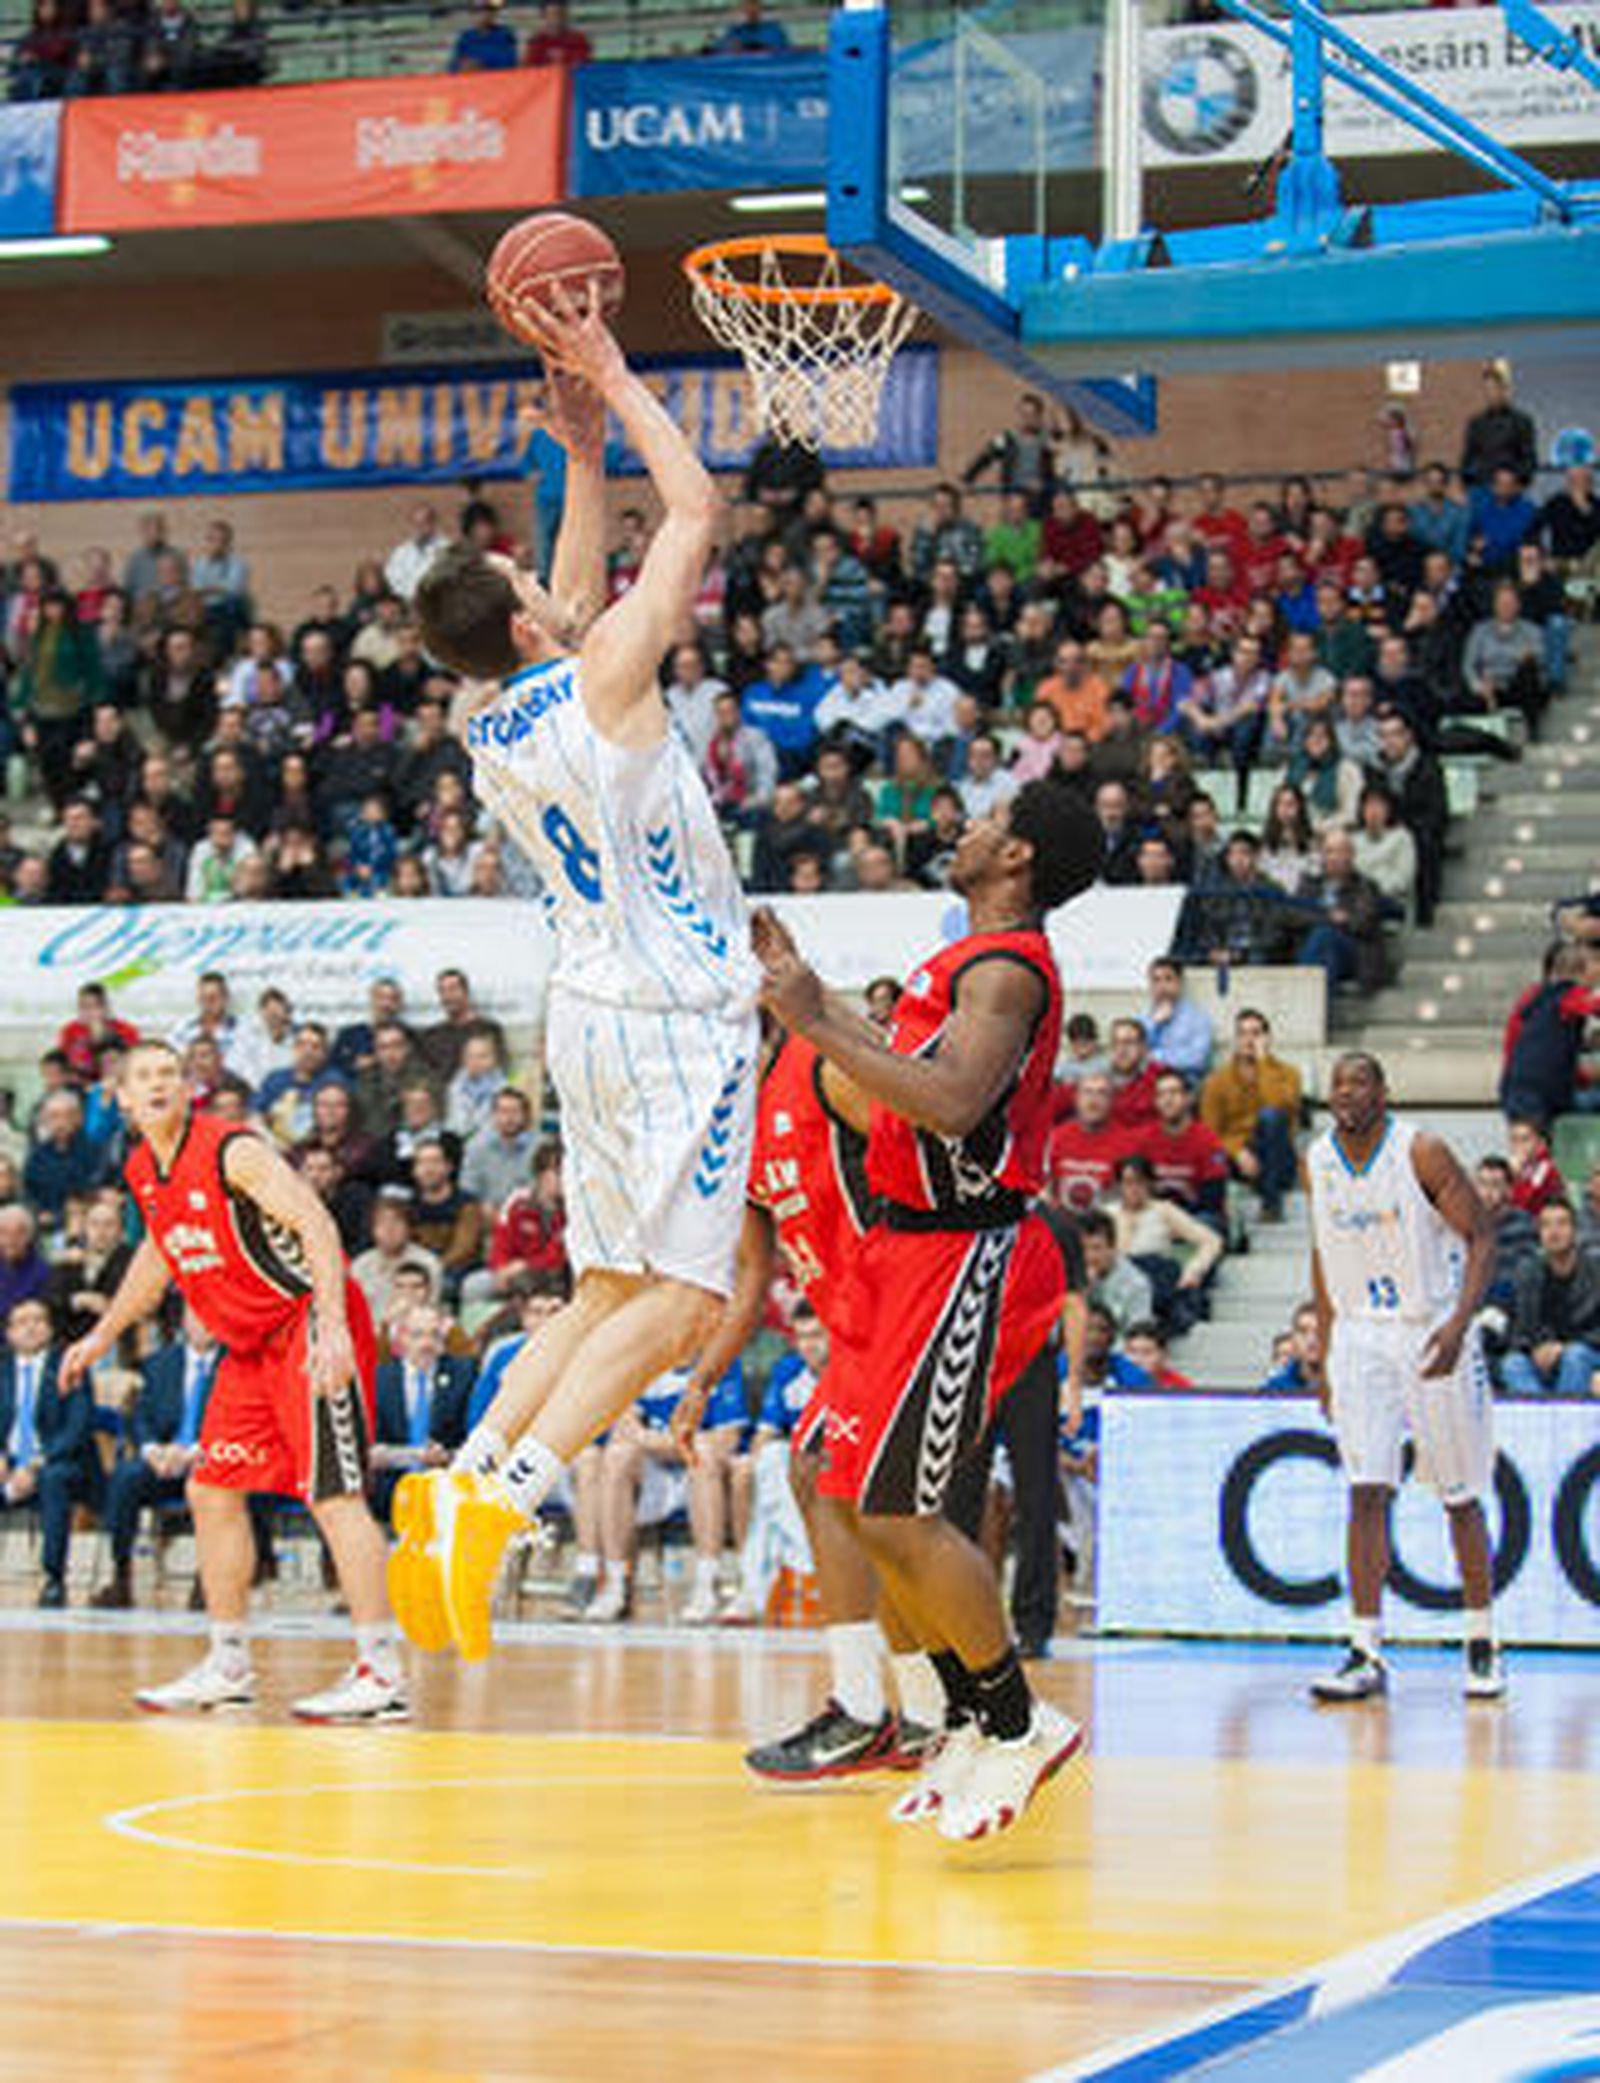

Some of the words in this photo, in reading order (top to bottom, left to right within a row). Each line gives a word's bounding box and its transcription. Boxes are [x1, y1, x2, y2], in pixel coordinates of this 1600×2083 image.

[585, 101, 744, 150] UCAM
[66, 395, 284, 478] UCAM
[541, 802, 603, 904] 8
[1367, 1274, 1399, 1309] 13
